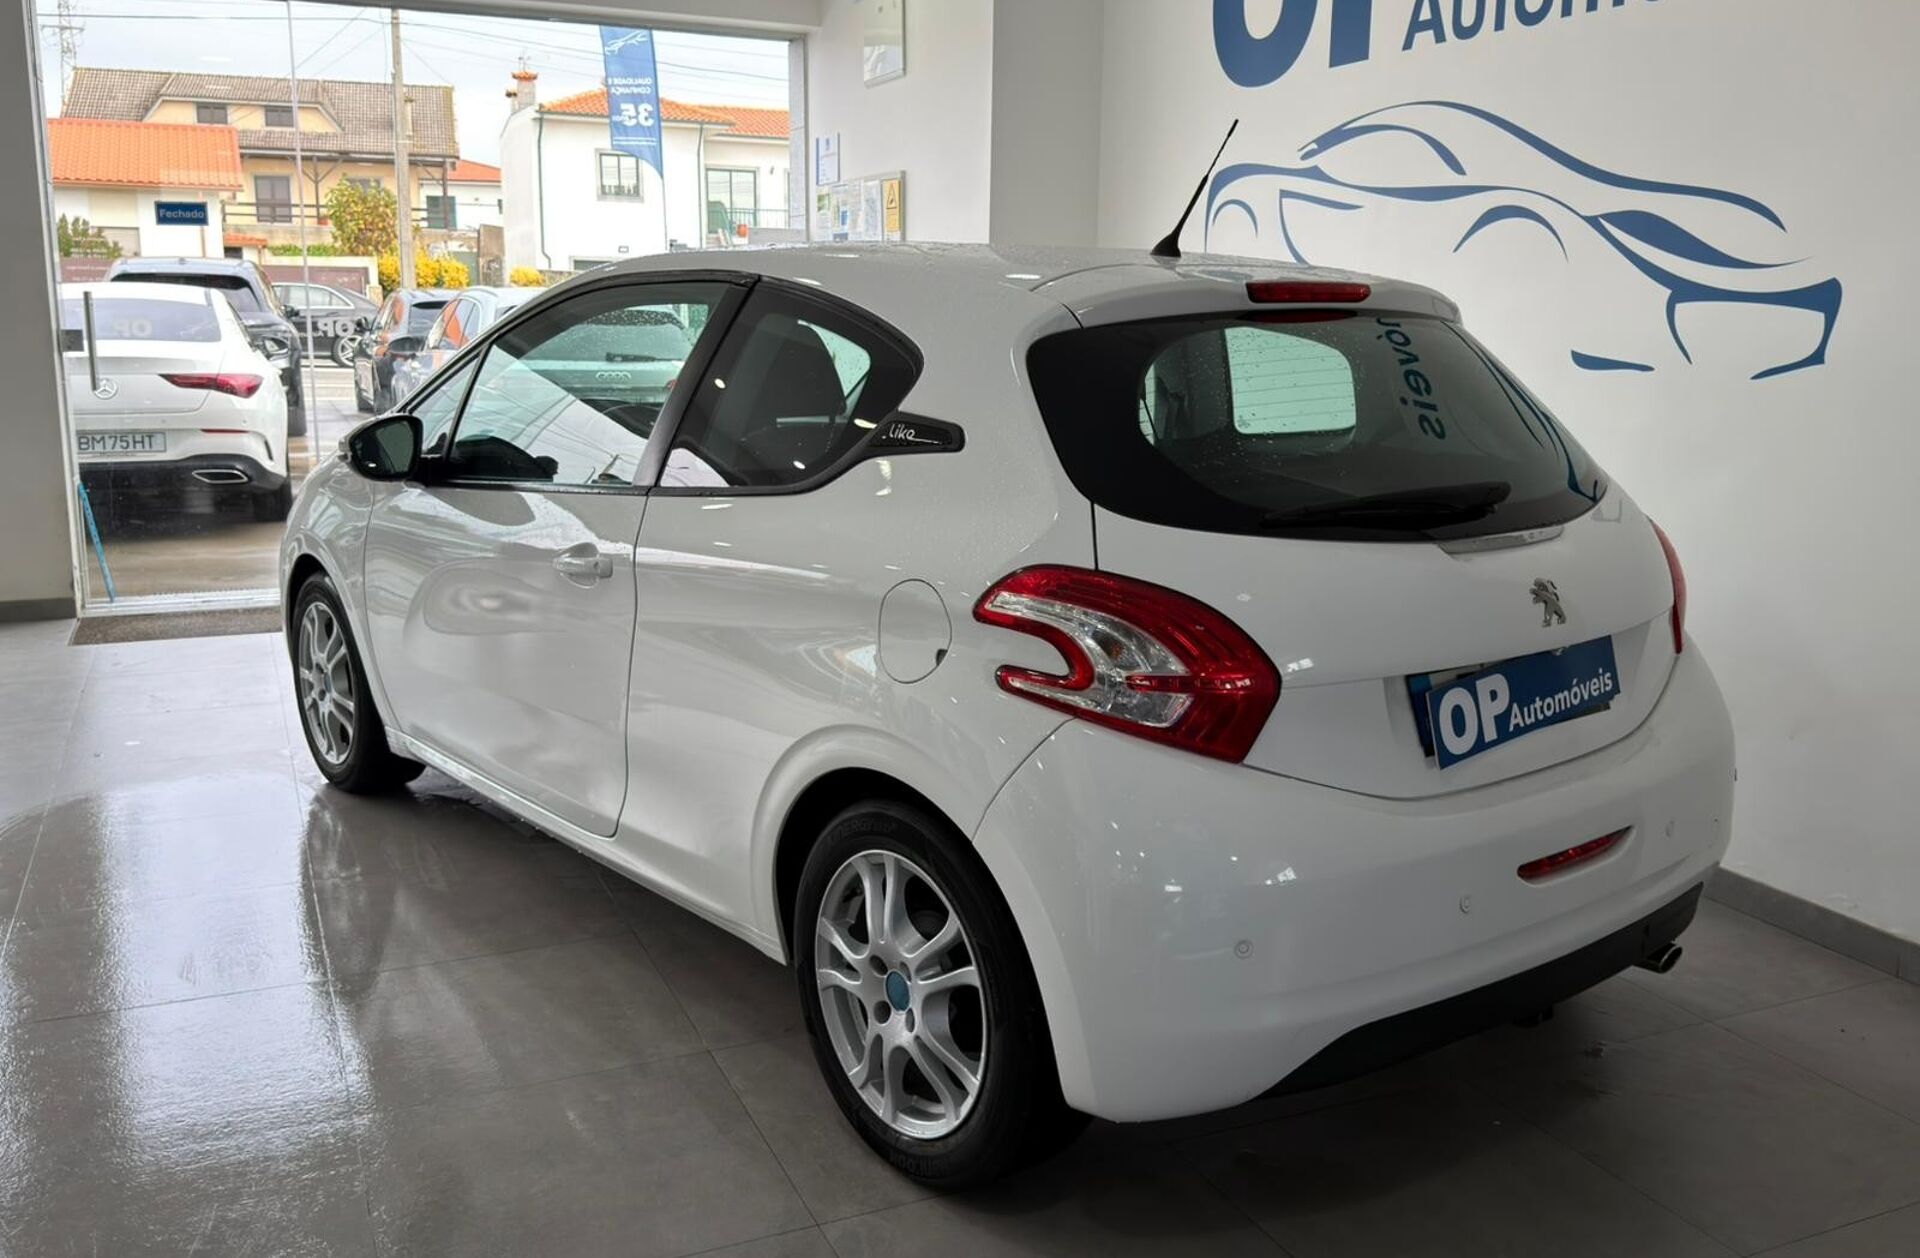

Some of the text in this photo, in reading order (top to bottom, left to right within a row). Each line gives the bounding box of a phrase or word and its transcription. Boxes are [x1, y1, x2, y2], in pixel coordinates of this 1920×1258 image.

[159, 208, 205, 218] Fechado
[1439, 667, 1613, 756] OP Automóveis
